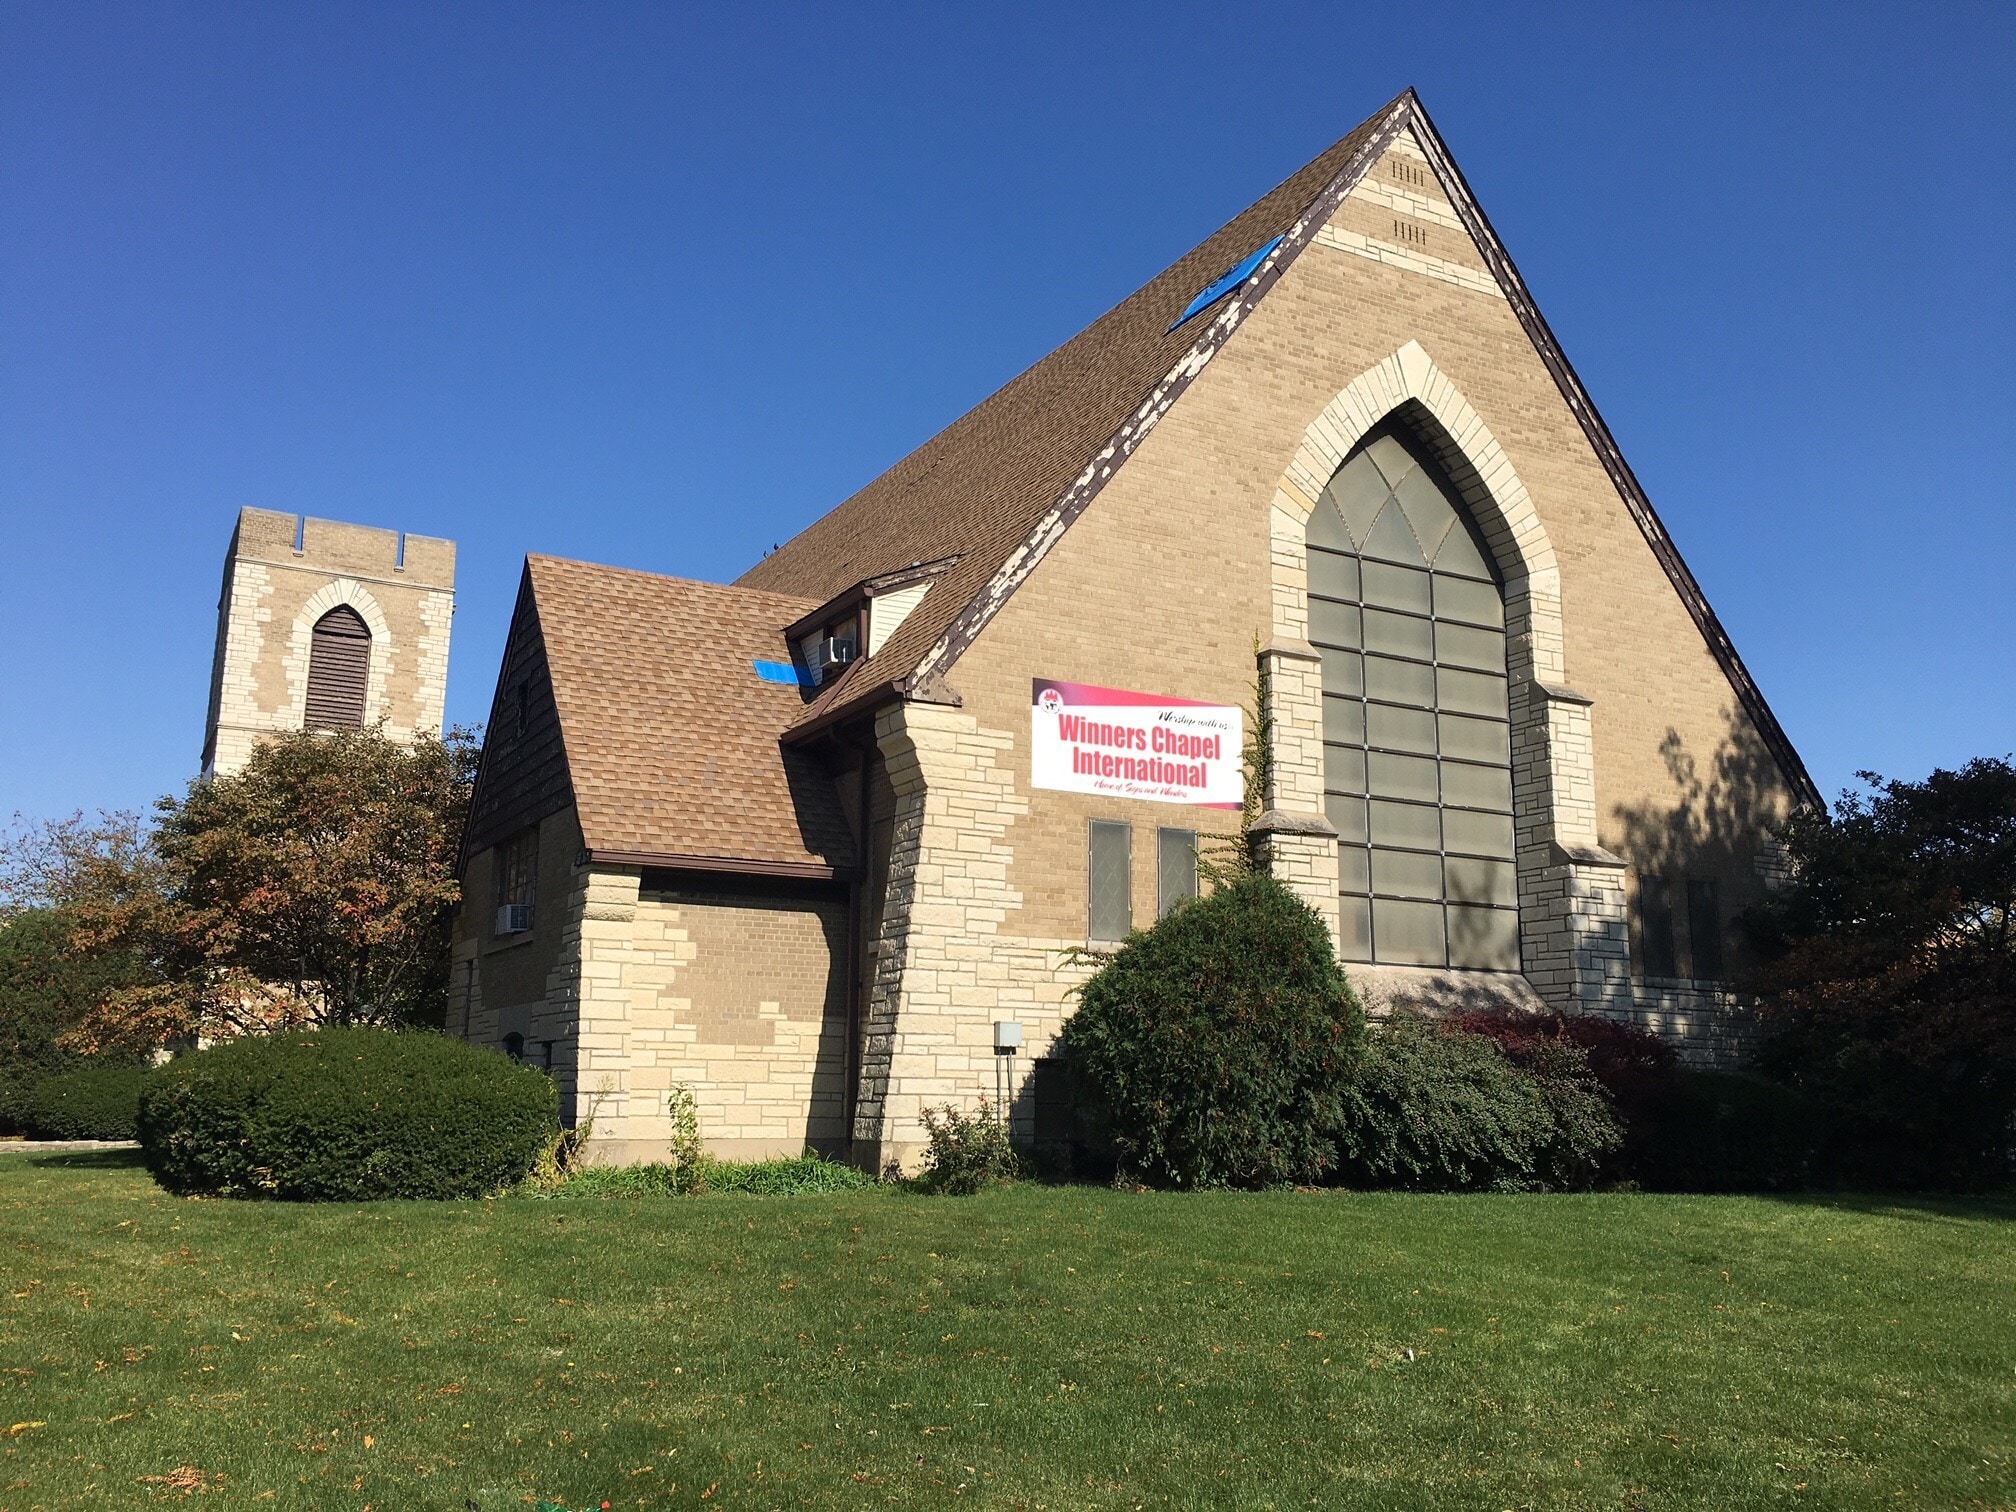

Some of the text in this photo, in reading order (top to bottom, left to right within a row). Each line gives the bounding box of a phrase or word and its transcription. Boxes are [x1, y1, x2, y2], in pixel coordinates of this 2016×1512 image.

[1058, 713, 1221, 760] Winners Chapel
[1158, 711, 1196, 727] Worship
[1198, 719, 1217, 728] with
[1073, 746, 1207, 788] International
